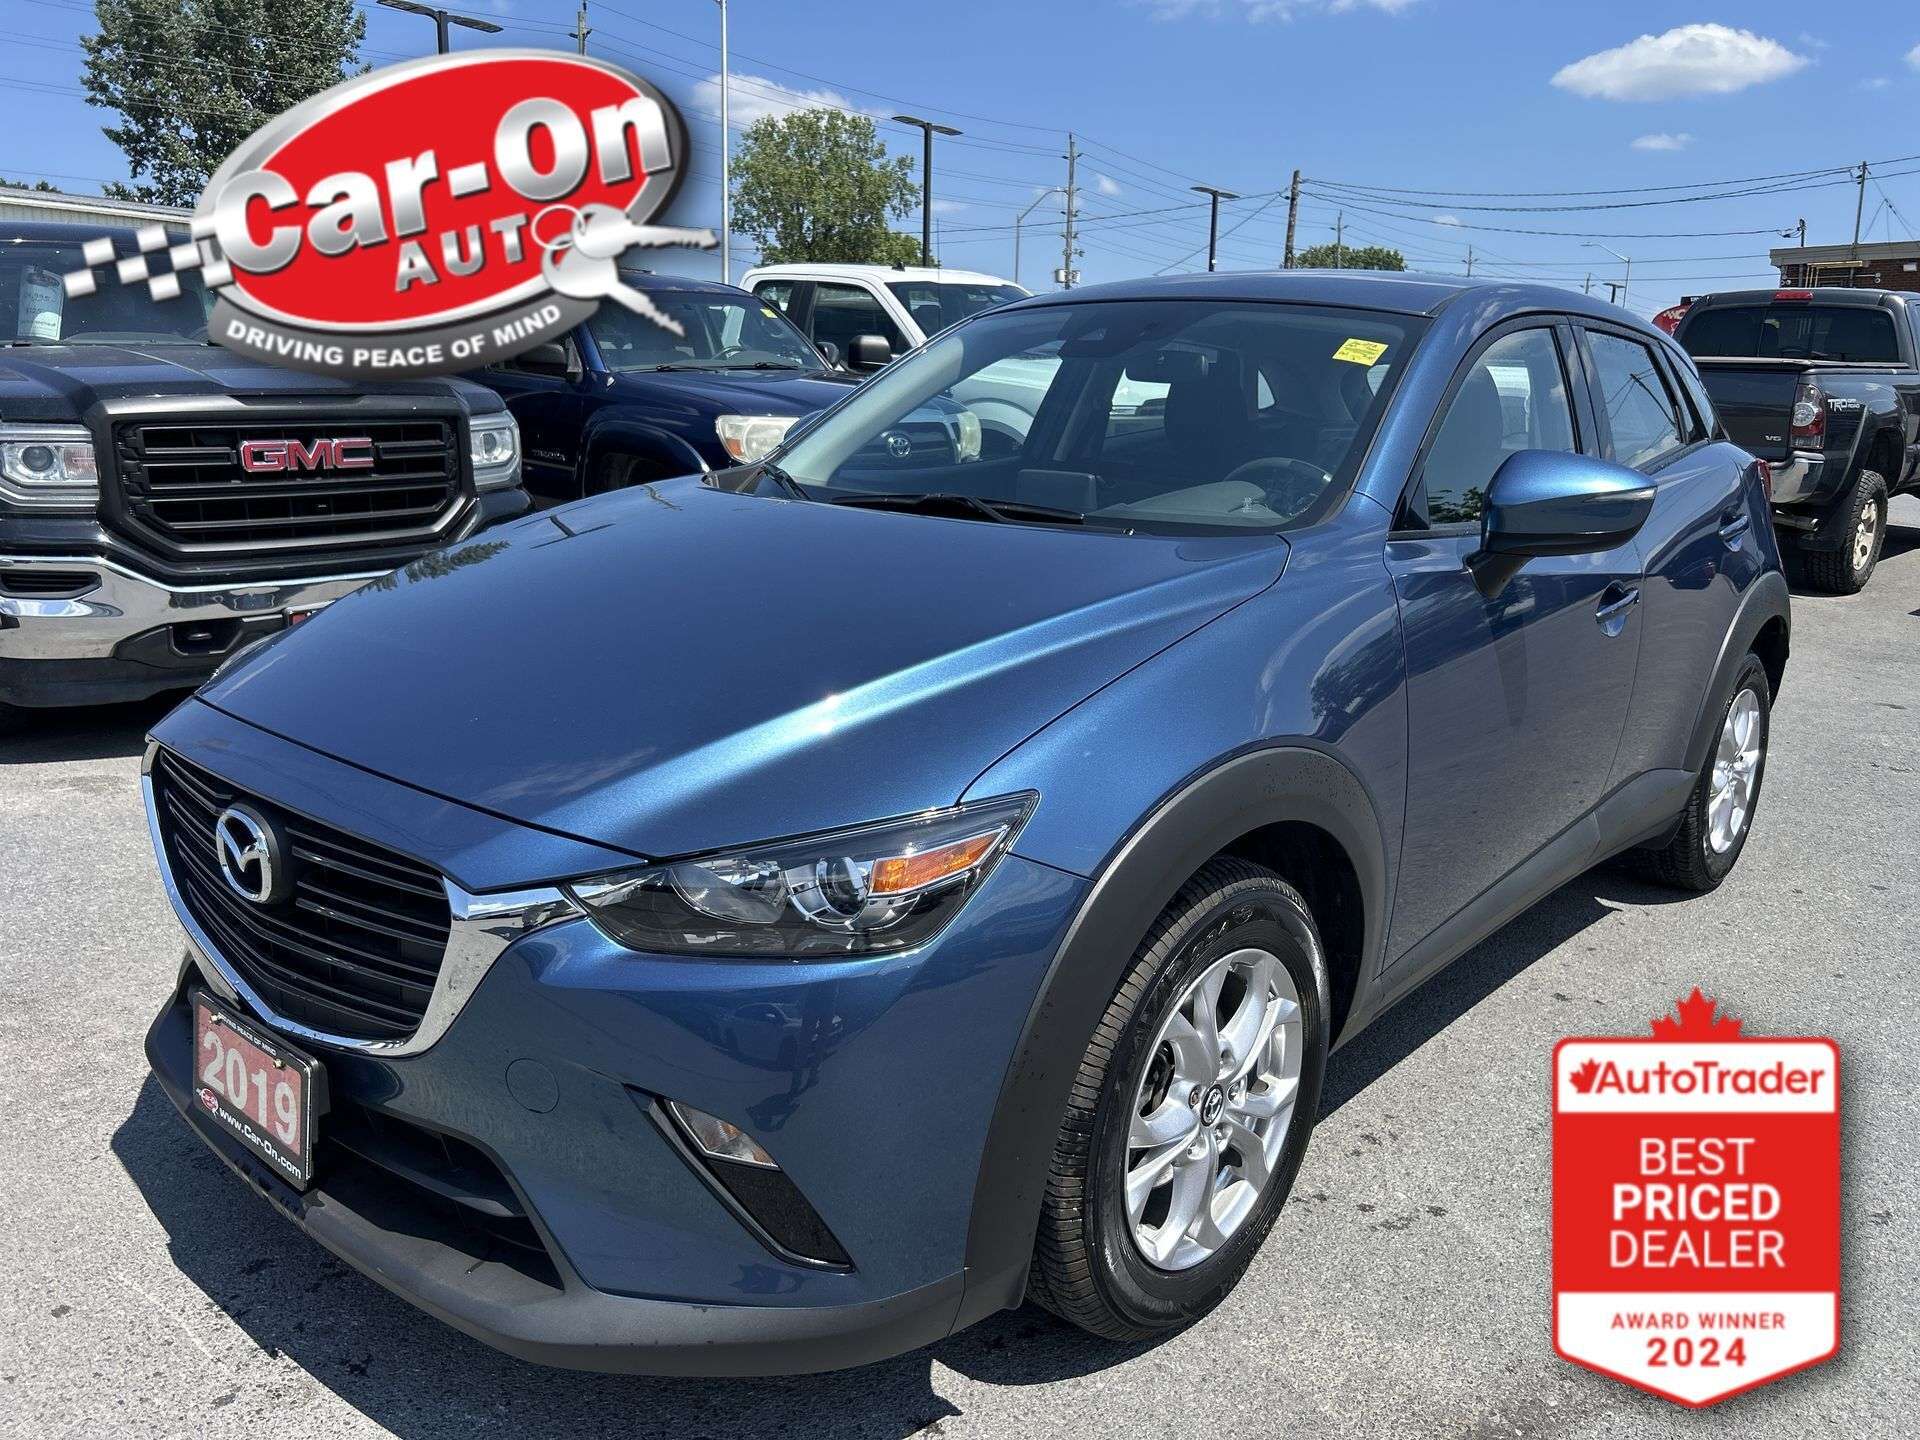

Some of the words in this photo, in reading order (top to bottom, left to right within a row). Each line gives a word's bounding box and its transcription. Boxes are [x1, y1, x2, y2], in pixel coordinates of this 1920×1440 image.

[240, 437, 374, 473] GMC
[203, 1031, 298, 1145] 2019
[219, 1107, 302, 1180] www.Car-On.com
